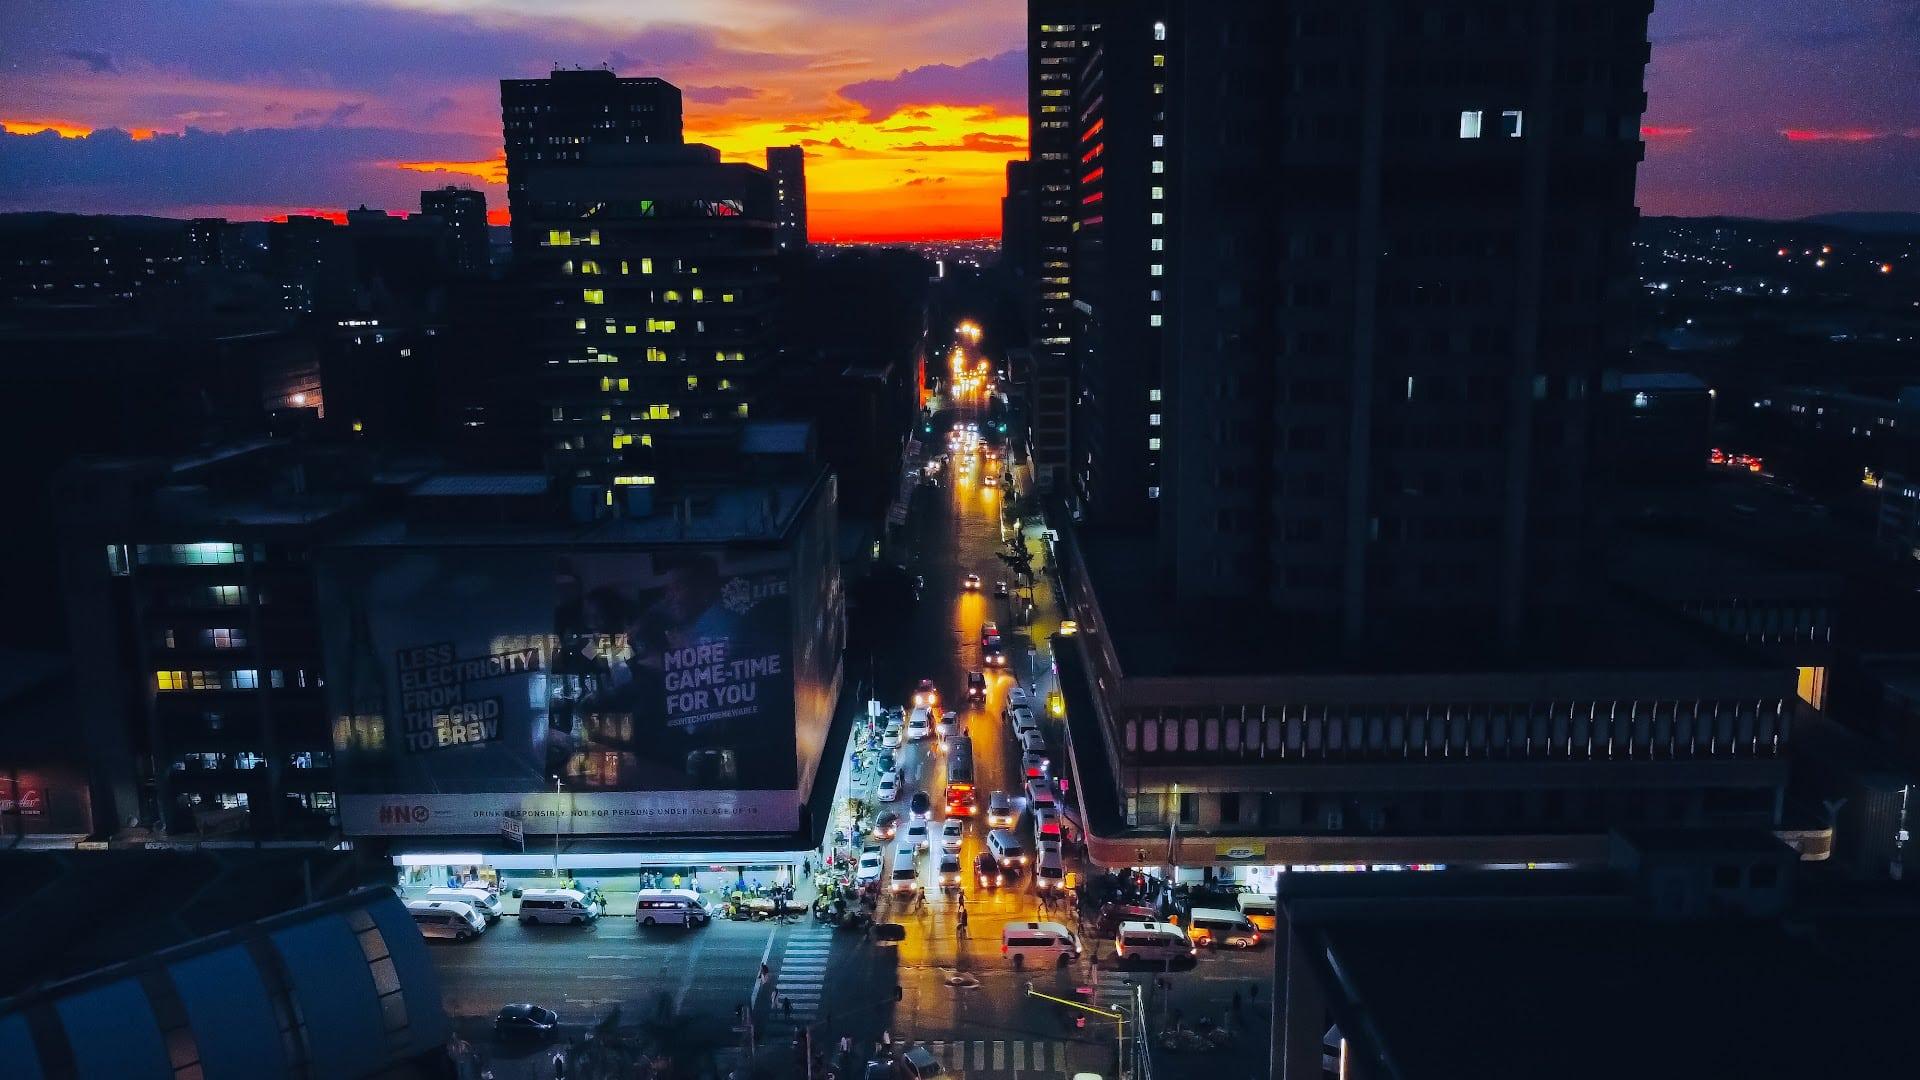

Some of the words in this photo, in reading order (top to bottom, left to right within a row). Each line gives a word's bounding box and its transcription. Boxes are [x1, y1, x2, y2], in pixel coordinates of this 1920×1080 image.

[753, 581, 787, 598] LITE
[401, 645, 450, 670] LESS
[402, 650, 533, 690] ELECTRICITY
[664, 642, 725, 672] MORE
[665, 654, 781, 691] GAME-TIME
[403, 683, 462, 712] FROM
[666, 690, 709, 715] FOR
[713, 681, 756, 707] YOU
[404, 708, 450, 731] THE
[449, 699, 499, 725] GRID
[406, 731, 434, 752] TO
[438, 719, 498, 747] BREW
[592, 809, 609, 817] FOR
